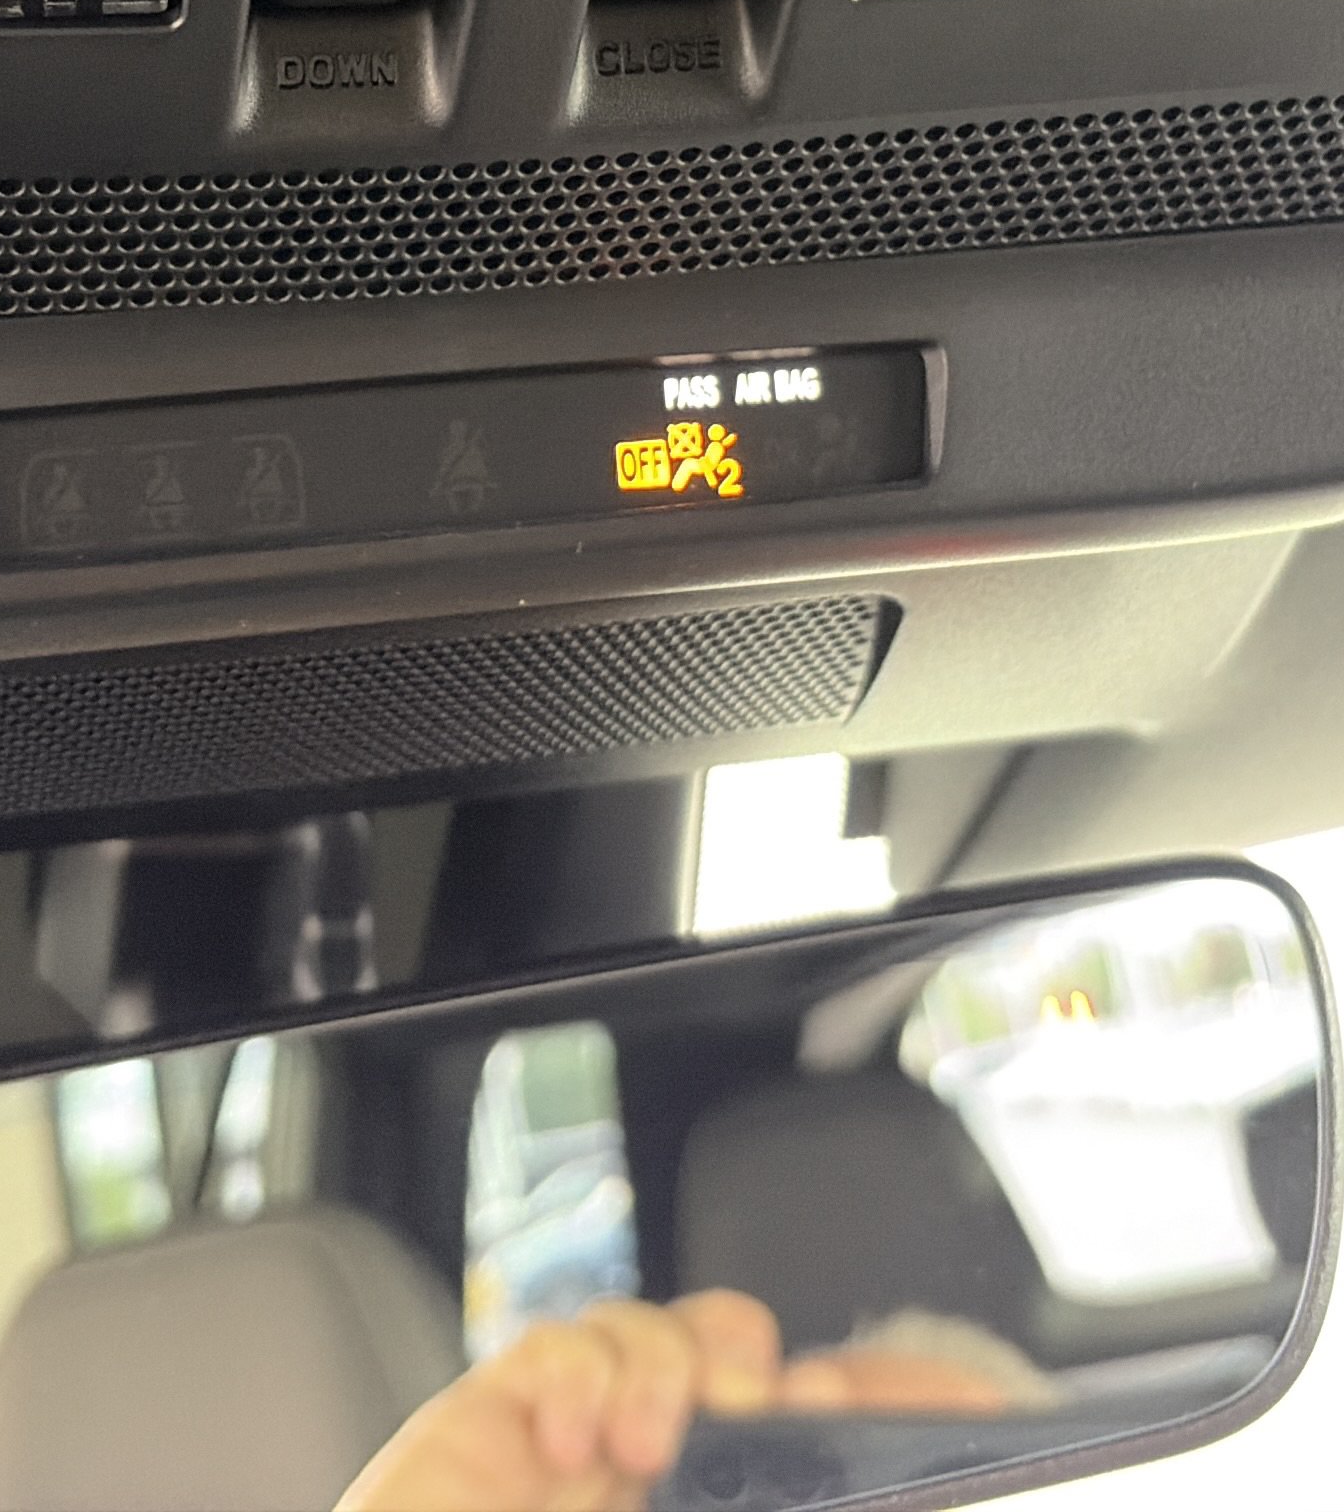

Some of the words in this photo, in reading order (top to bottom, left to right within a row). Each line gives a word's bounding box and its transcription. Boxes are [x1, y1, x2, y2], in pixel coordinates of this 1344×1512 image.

[276, 54, 398, 89] DOWN
[594, 39, 722, 76] CLOSE
[663, 374, 721, 411] PASS
[735, 370, 772, 406] AIR
[773, 366, 823, 404] BAG
[621, 445, 663, 482] OFF
[716, 457, 745, 499] 2
